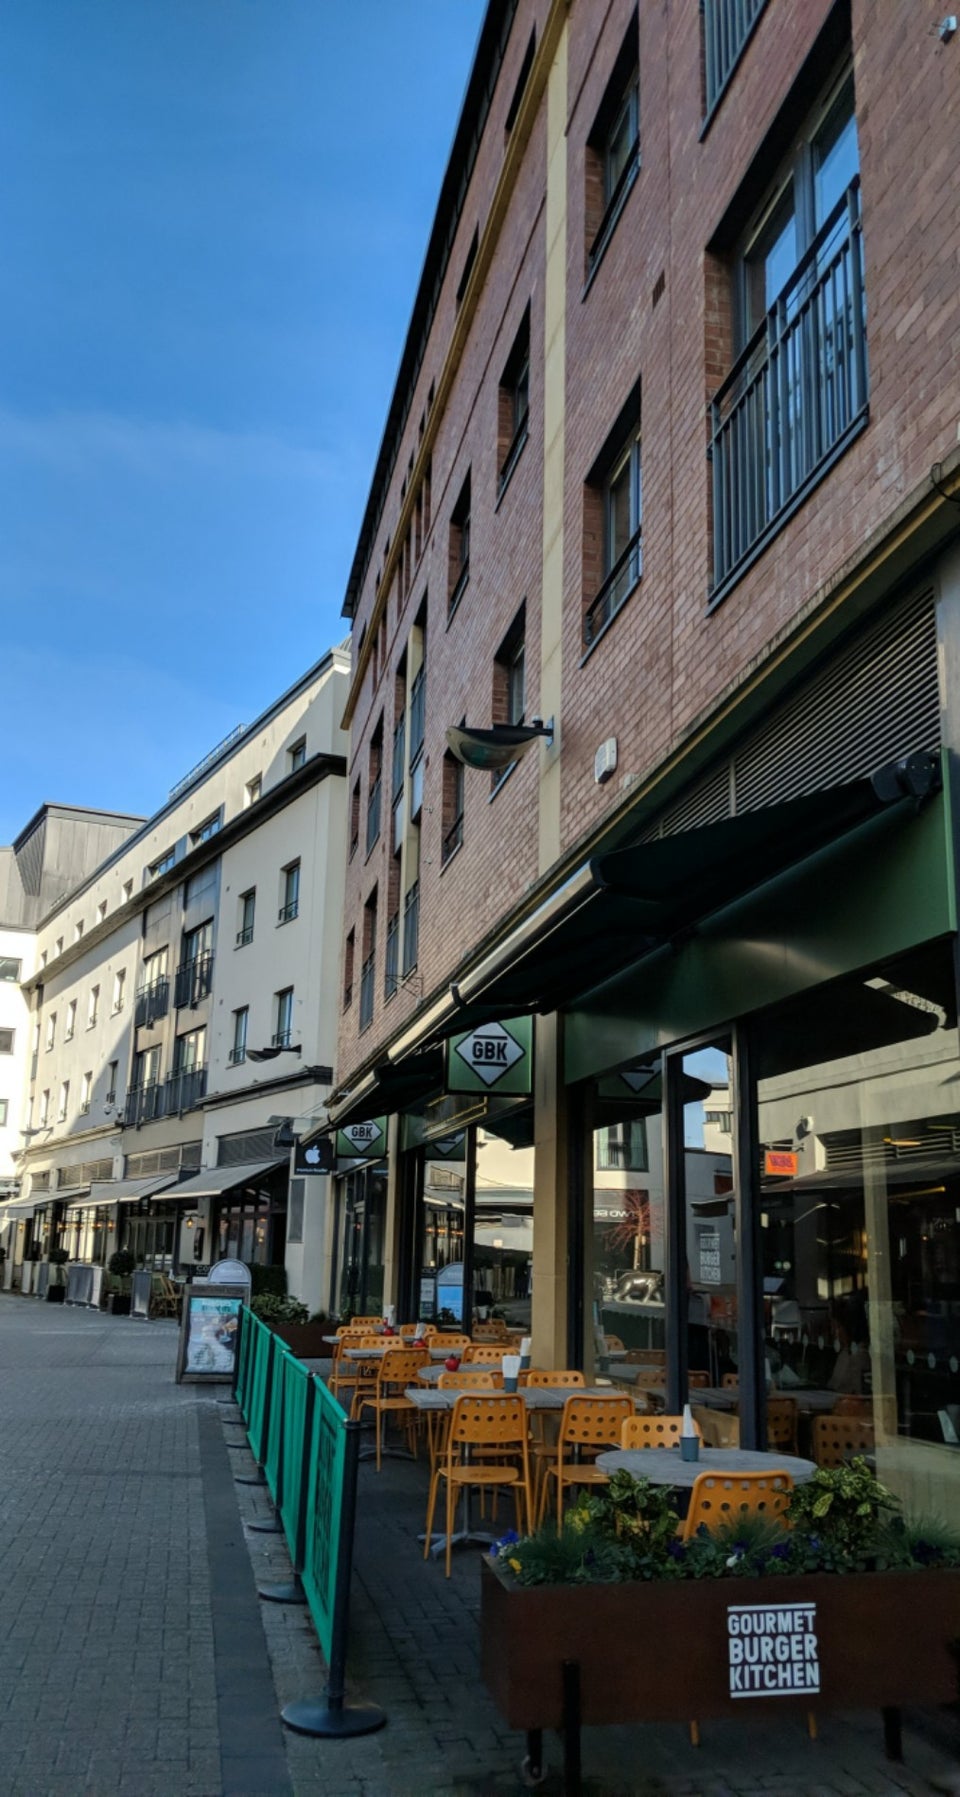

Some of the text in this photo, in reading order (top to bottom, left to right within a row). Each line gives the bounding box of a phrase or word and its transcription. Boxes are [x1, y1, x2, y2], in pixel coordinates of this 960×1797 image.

[472, 1041, 508, 1061] GBK
[351, 1126, 373, 1138] GBK
[727, 1610, 817, 1635] GOURMET
[728, 1633, 818, 1664] BURGER
[729, 1661, 820, 1690] KITCHEN
